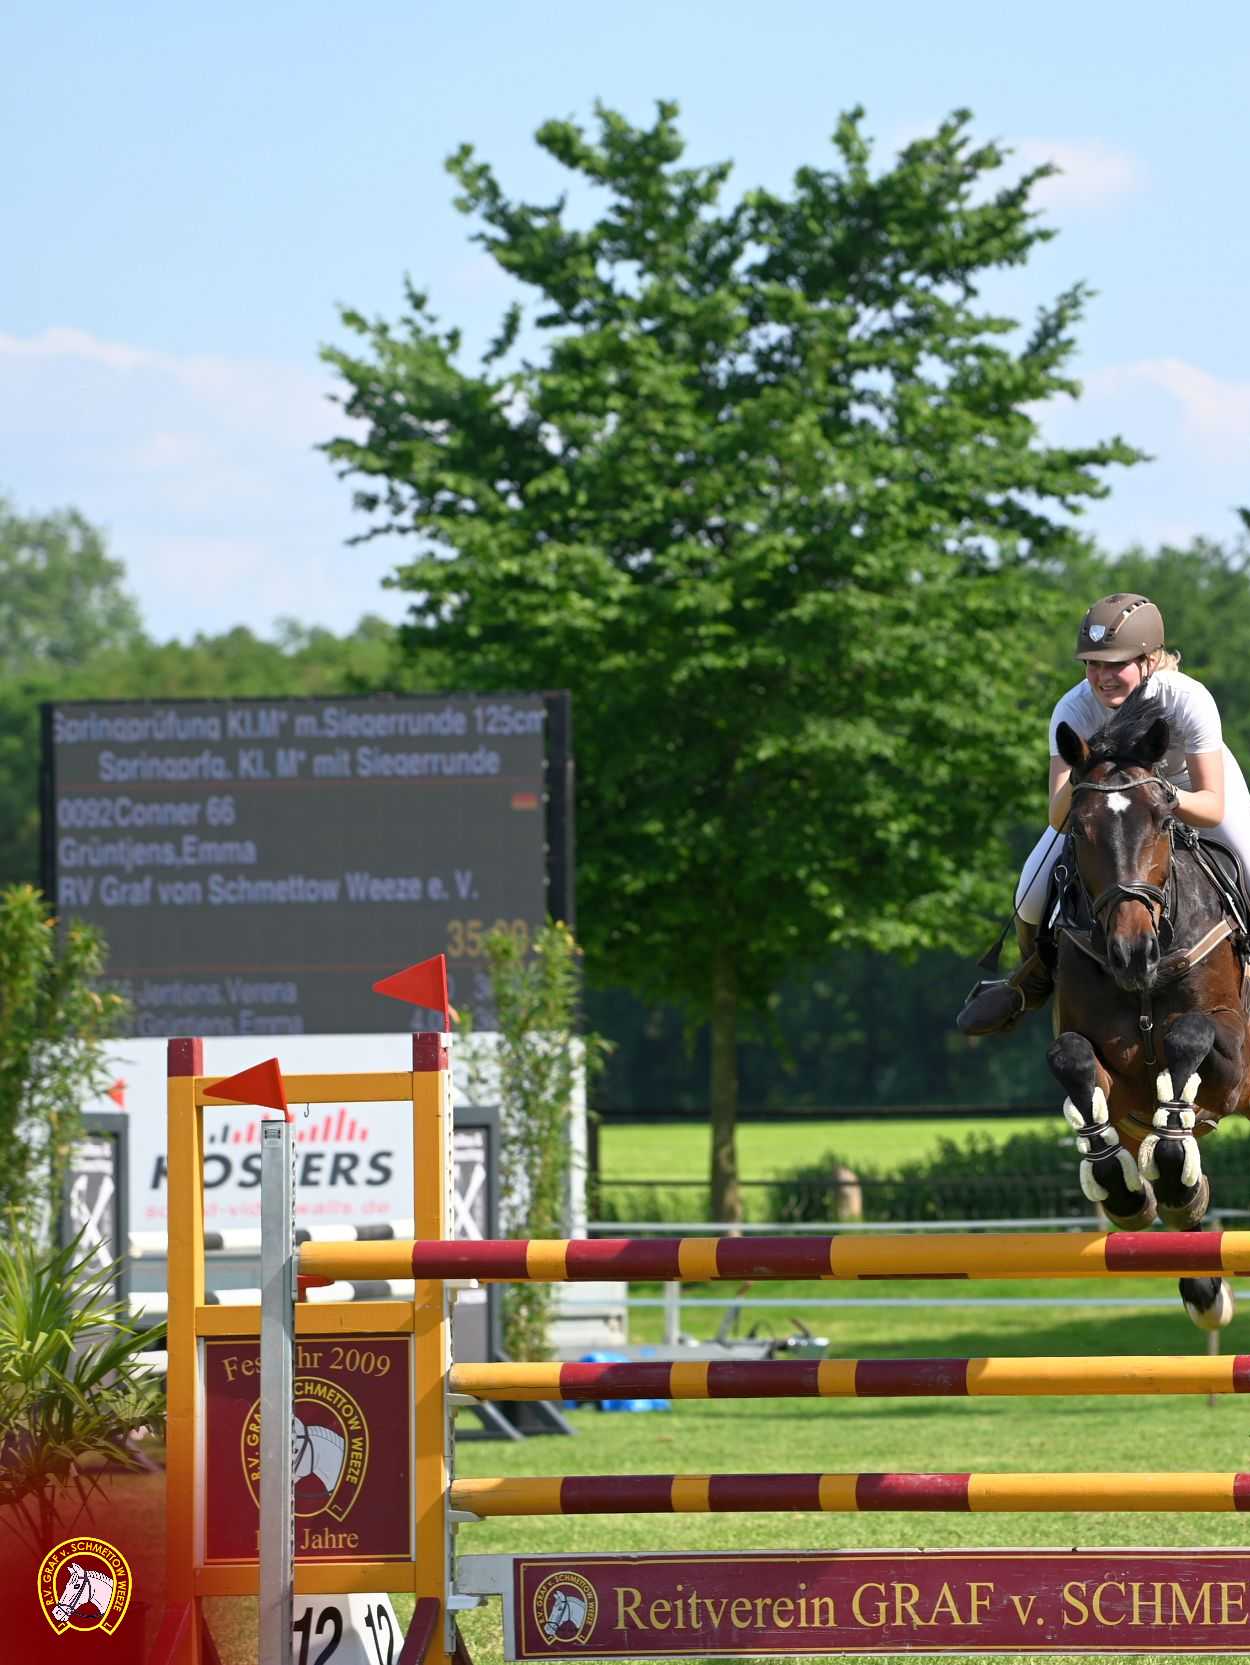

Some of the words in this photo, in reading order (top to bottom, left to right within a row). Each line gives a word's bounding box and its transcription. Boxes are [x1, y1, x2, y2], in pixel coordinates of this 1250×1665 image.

[473, 703, 545, 735] 125cm
[313, 746, 351, 777] mit
[206, 794, 236, 827] 66
[58, 874, 94, 905] RV
[100, 873, 153, 905] Graf
[158, 879, 201, 904] von
[207, 872, 341, 904] Schmettow
[345, 870, 422, 901] Weeze
[151, 1150, 394, 1190] OSERS
[222, 1346, 323, 1382] Feshr
[329, 1347, 391, 1377] 2009
[293, 1382, 361, 1430] CHMETTOW
[345, 1436, 364, 1485] WEEZE
[300, 1527, 360, 1550] Jahre
[612, 1582, 838, 1630] Reitverein
[852, 1582, 995, 1628] GRAF
[1009, 1594, 1046, 1626] v.
[293, 1606, 343, 1665] 12
[364, 1604, 395, 1665] 12
